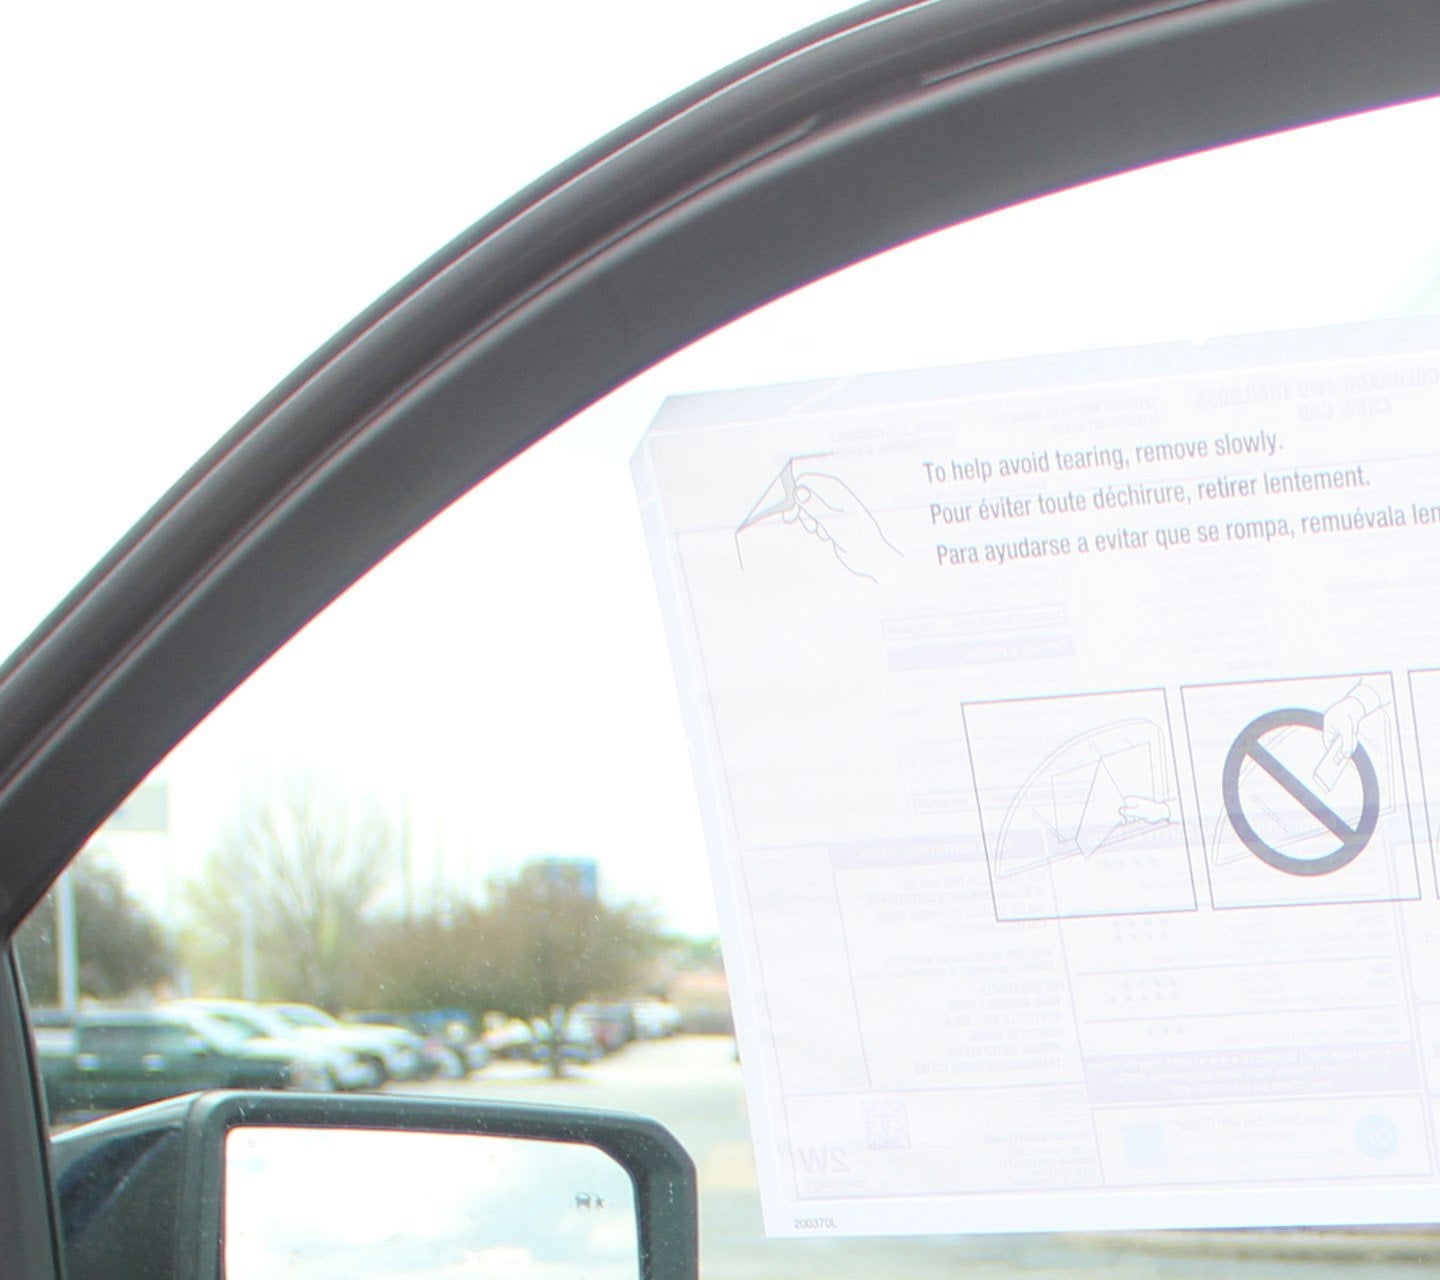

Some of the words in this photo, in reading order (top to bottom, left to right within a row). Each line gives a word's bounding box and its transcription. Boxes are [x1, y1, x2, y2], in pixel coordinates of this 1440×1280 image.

[922, 461, 946, 484] To
[952, 456, 993, 484] help
[999, 450, 1050, 477] avoid
[1056, 444, 1130, 470] tearing,
[1135, 438, 1209, 464] remove
[1215, 429, 1285, 457] slowly.
[930, 501, 972, 525] Pour
[979, 496, 1031, 521] éviter
[1038, 490, 1087, 514] toute
[1093, 483, 1192, 509] déchirure,
[1197, 476, 1258, 501] retirer
[1264, 464, 1371, 495] lentement.
[936, 543, 979, 566] Para
[985, 537, 1071, 566] ayudarse
[1077, 535, 1089, 555] a
[1095, 528, 1149, 553] evitar
[1156, 524, 1191, 550] que
[1198, 523, 1220, 543] se
[1227, 517, 1295, 542] rompa,
[1301, 505, 1406, 535] remuévala
